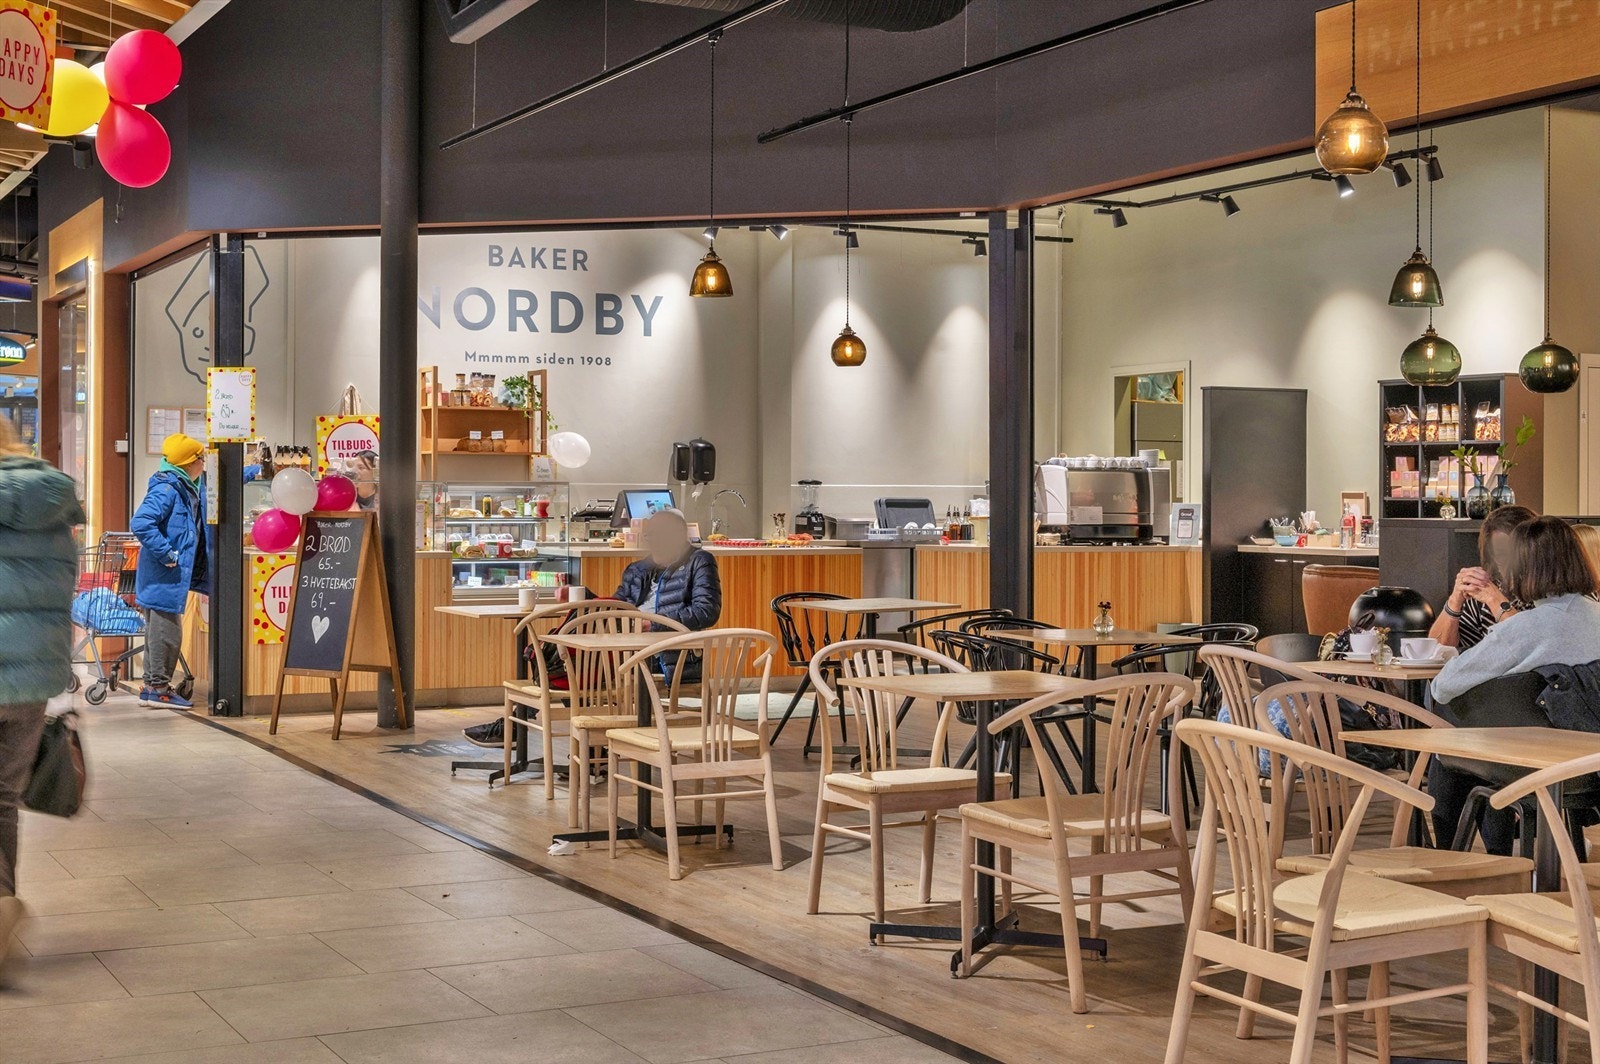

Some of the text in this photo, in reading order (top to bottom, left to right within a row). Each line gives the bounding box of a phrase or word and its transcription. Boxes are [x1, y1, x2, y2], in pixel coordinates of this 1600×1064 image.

[4, 38, 41, 65] APPY
[0, 58, 35, 86] DAYS
[488, 244, 589, 272] BAKER
[418, 286, 664, 337] NORDBY
[0, 346, 23, 359] rønn
[464, 350, 612, 367] Mmmmm siden 1908
[332, 439, 375, 451] TILBUDS-
[305, 534, 352, 554] 2 BRØD
[301, 575, 358, 590] 3 HVETEBAKST
